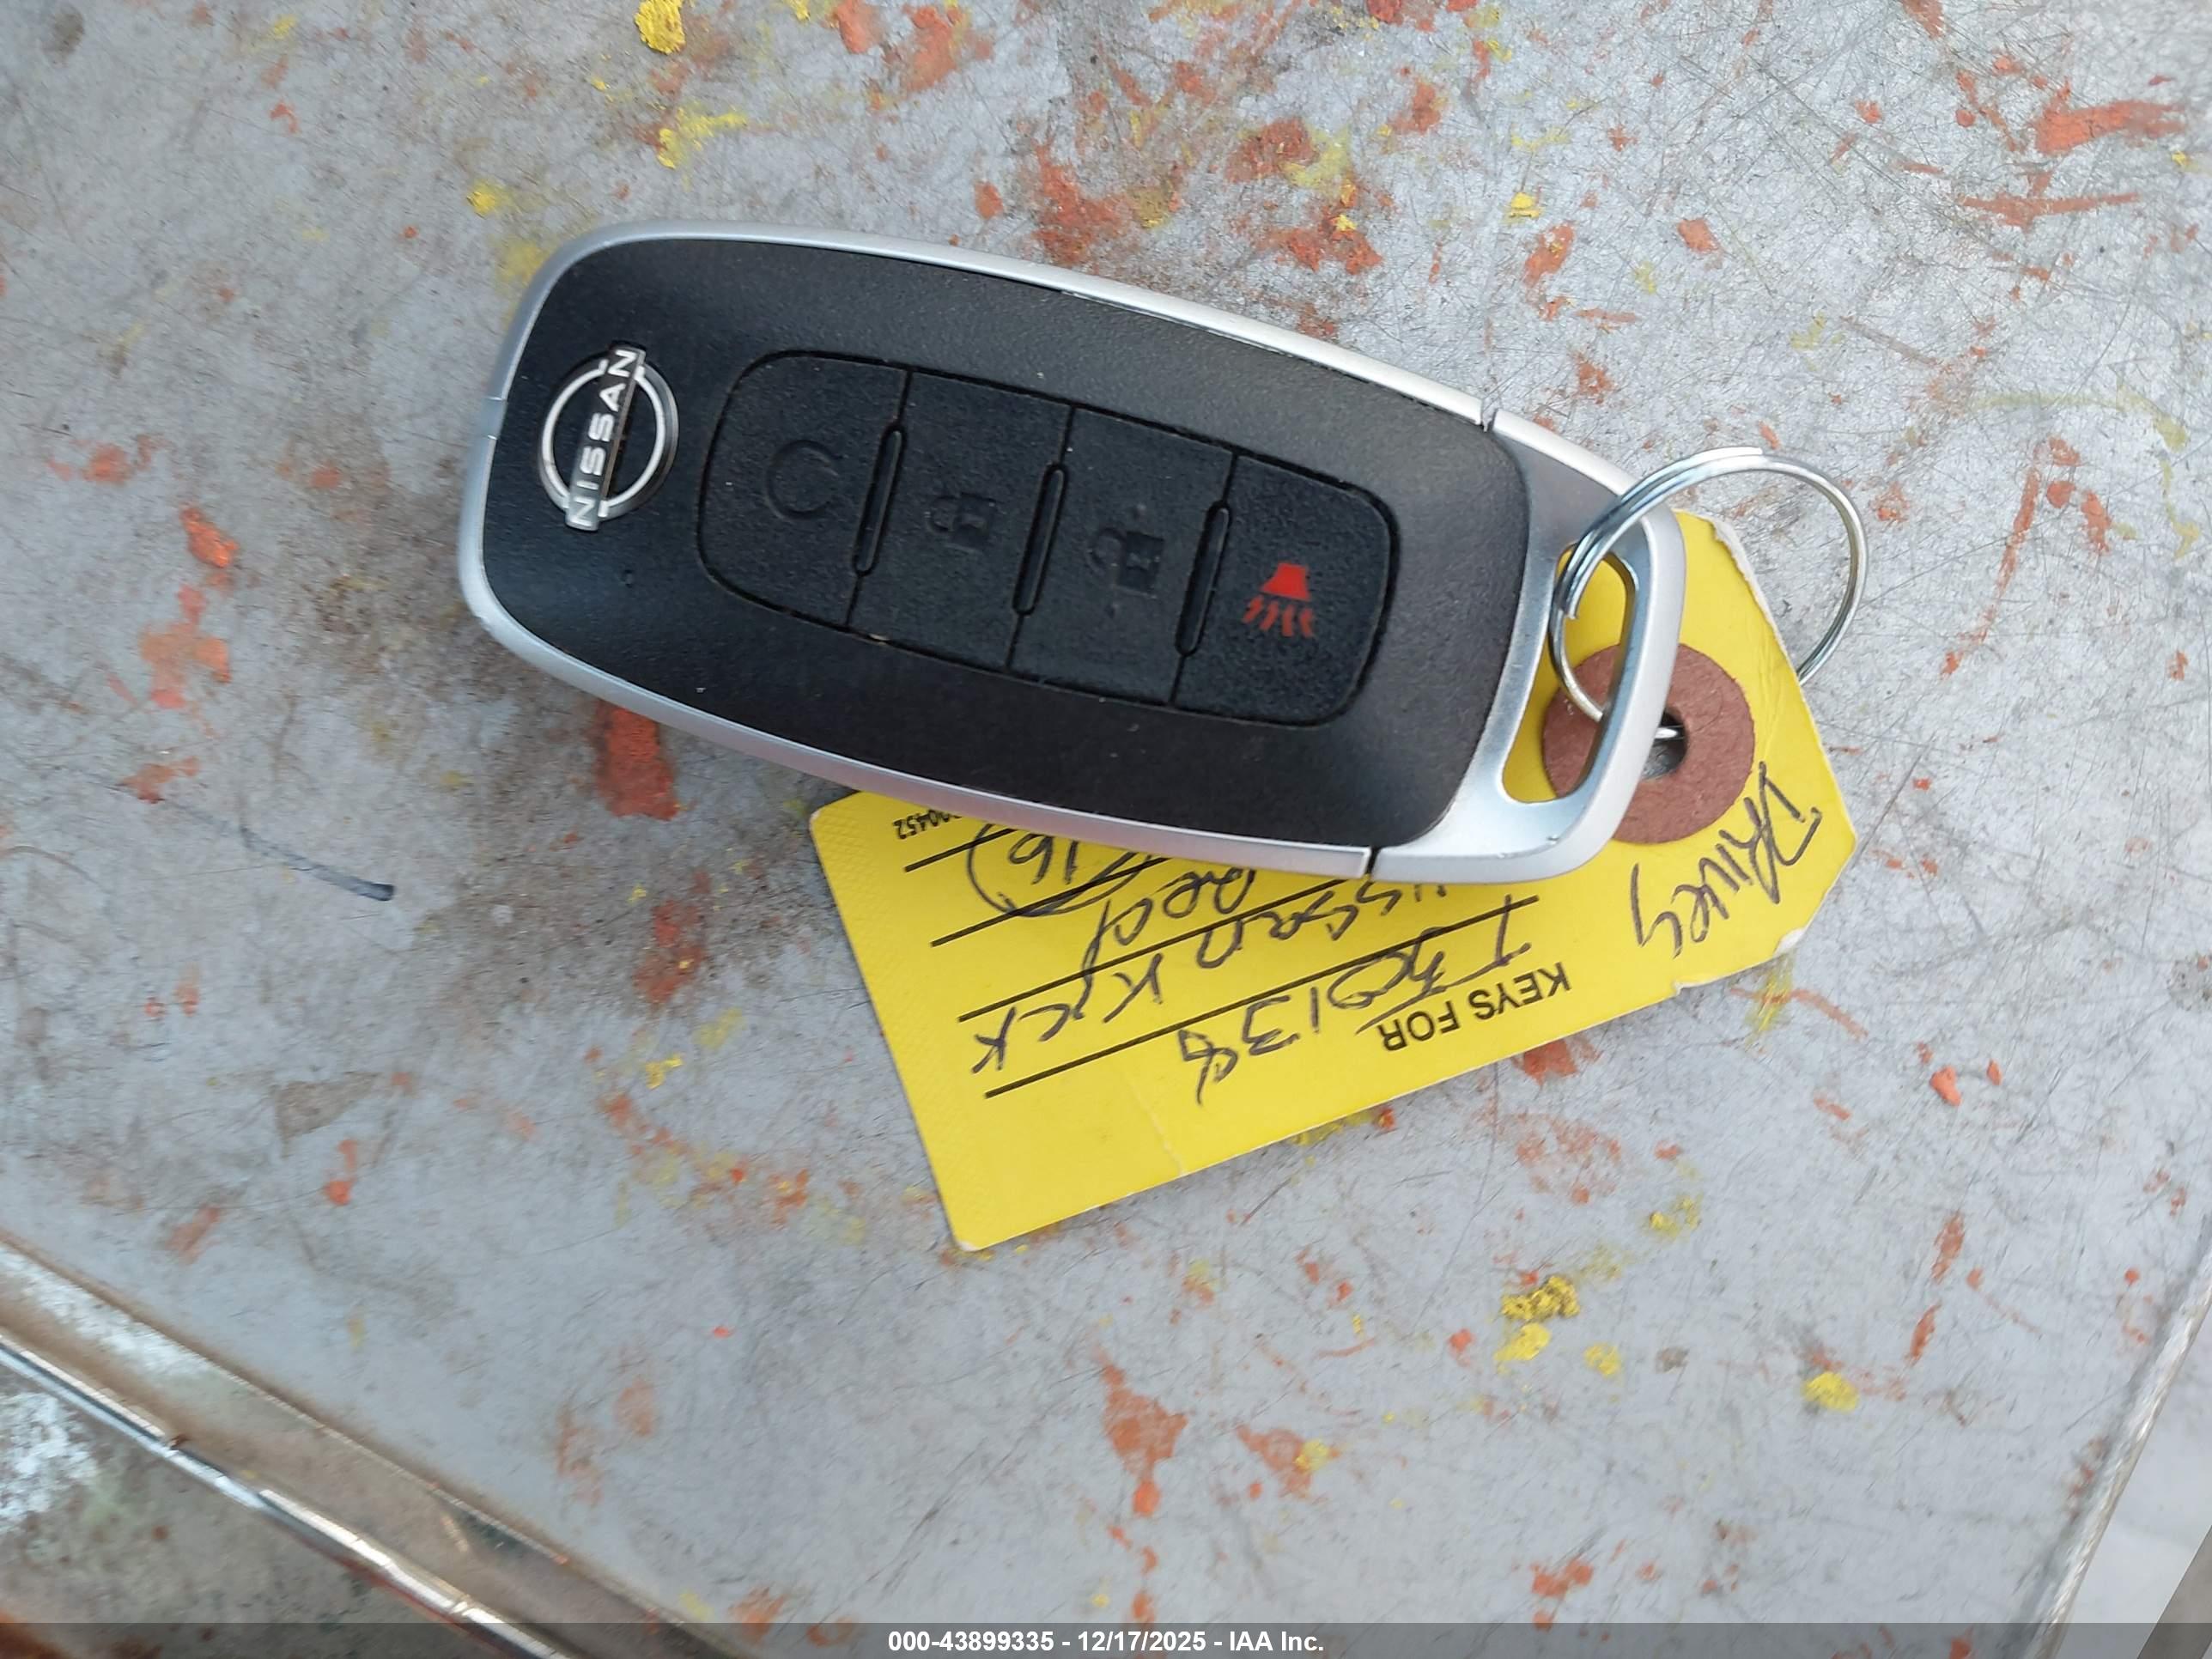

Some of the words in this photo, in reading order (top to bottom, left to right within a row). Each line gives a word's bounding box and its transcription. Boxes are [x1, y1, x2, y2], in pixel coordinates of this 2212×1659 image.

[569, 349, 637, 527] NISSAN
[1468, 962, 1571, 1021] KEYS
[1376, 1001, 1462, 1052] FOR
